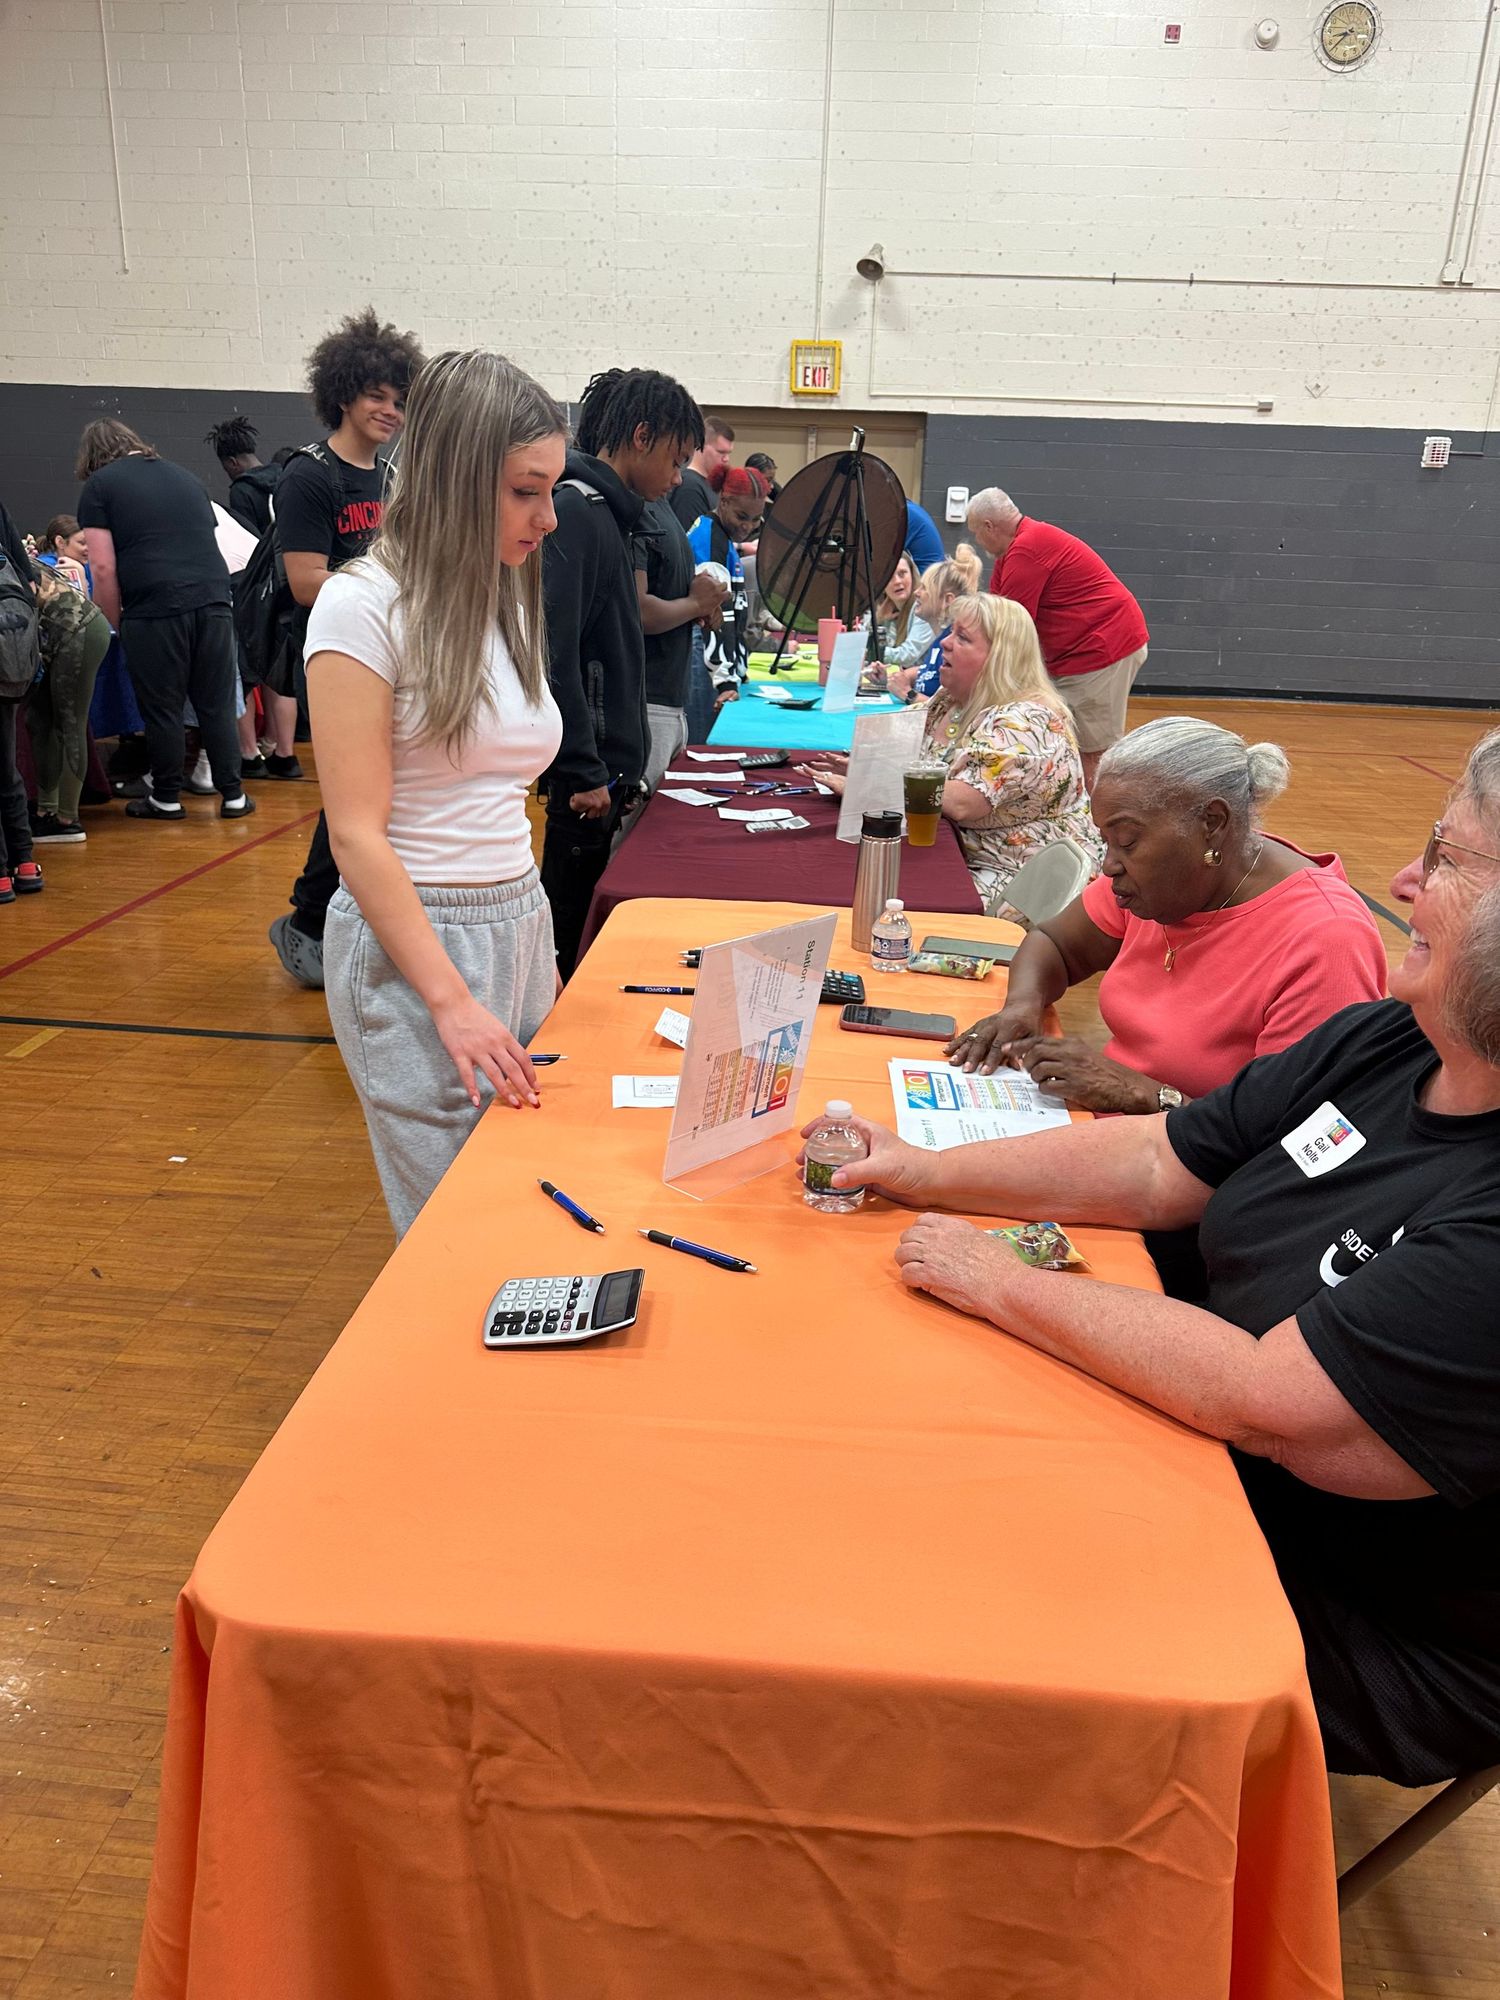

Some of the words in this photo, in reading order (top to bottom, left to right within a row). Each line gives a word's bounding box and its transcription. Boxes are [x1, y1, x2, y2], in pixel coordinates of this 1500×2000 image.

[803, 366, 828, 387] EXIT
[800, 940, 815, 983] Station
[796, 986, 805, 1000] 11
[763, 1045, 778, 1098] Entertainment
[905, 1071, 931, 1090] 101
[770, 1063, 793, 1106] 101
[935, 1078, 946, 1102] Entertainment
[925, 1127, 936, 1146] Station
[1314, 1137, 1330, 1153] Gail
[1301, 1143, 1319, 1163] Nolte
[1340, 1228, 1378, 1262] SIDE
